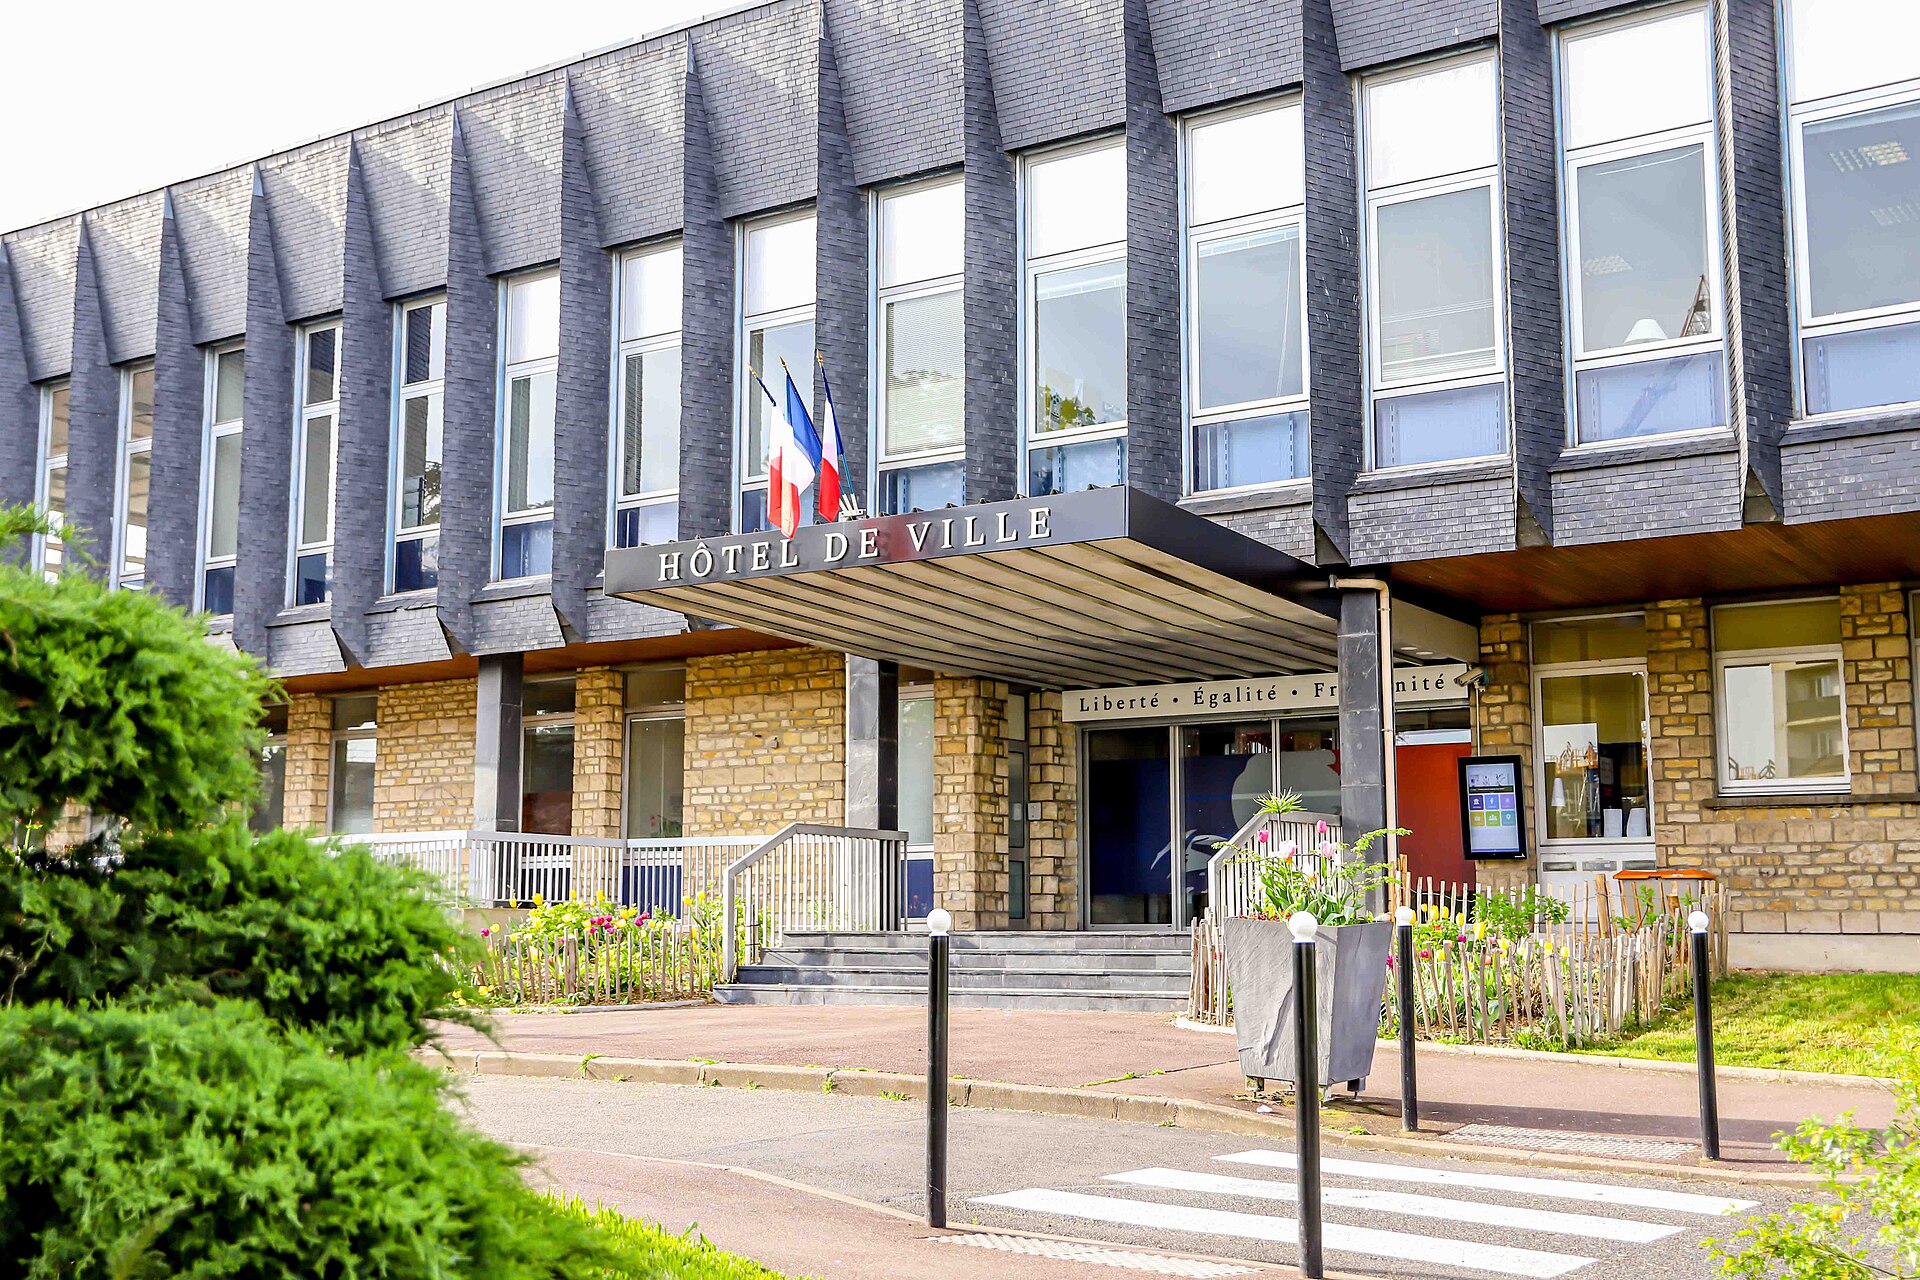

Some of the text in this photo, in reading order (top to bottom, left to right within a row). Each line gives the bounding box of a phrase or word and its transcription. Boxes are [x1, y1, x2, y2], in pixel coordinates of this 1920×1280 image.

[657, 507, 1052, 582] HÔTEL DE VILLE
[1079, 673, 1445, 713] Liberté Égalité Frnité
